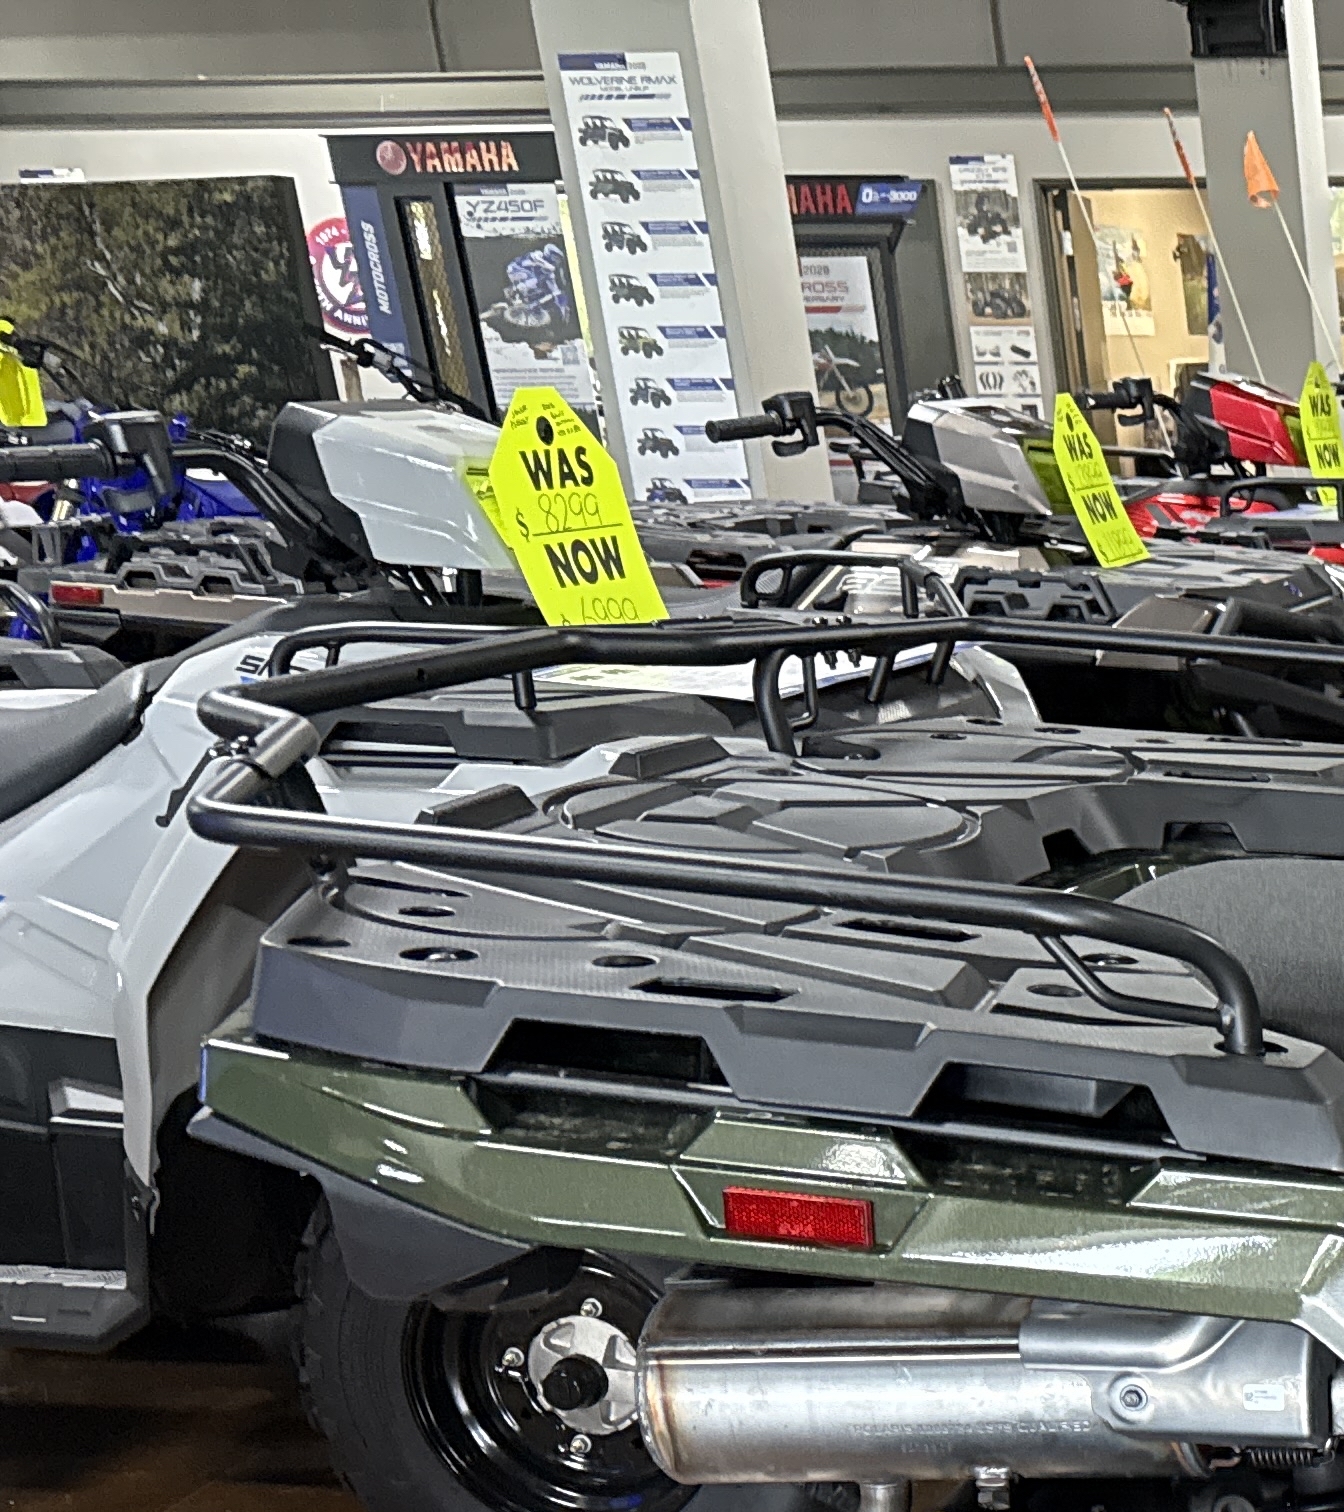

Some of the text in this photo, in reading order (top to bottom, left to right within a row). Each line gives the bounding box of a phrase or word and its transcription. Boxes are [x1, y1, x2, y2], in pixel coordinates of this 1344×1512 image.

[405, 141, 520, 173] YAMAHA
[466, 199, 545, 214] YZ450F
[361, 220, 392, 315] MOTOCROSS
[1309, 394, 1332, 417] WAS
[1062, 432, 1094, 462] WAS
[1314, 443, 1341, 470] NOW
[518, 445, 594, 491] WAS
[537, 492, 603, 533] 8299
[1081, 490, 1118, 525] NOW
[543, 535, 626, 588] NOW
